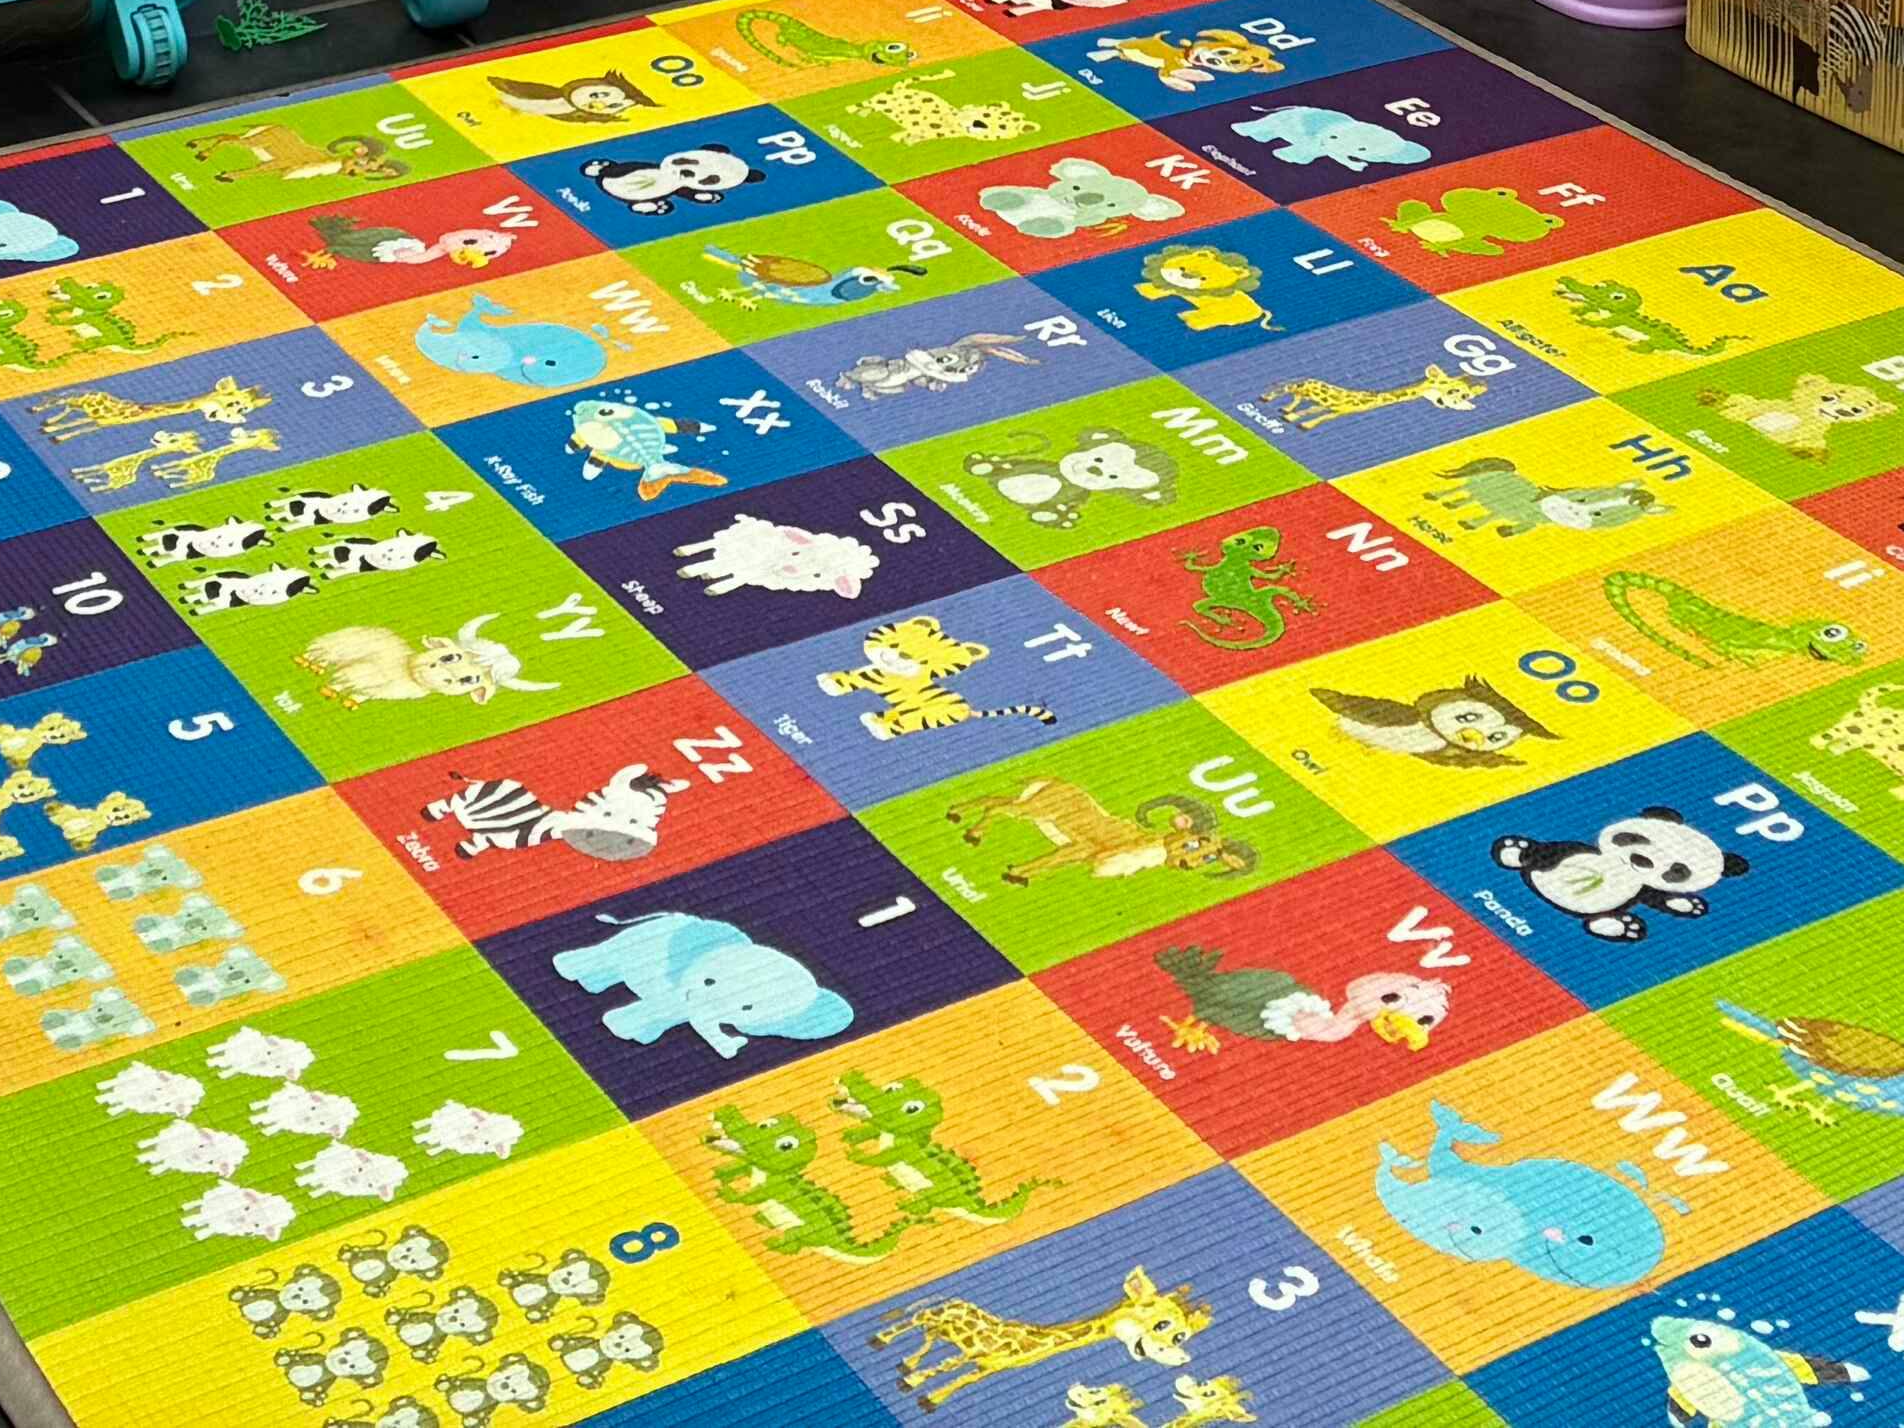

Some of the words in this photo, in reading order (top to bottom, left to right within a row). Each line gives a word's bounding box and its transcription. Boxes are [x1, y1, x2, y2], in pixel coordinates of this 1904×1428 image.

[1239, 16, 1316, 53] Dd
[650, 55, 704, 88] Oo
[1021, 79, 1072, 101] Jj
[375, 112, 434, 151] Uu
[1383, 96, 1442, 129] Ee
[756, 129, 818, 166] Pp
[1144, 153, 1211, 192] Kk
[100, 186, 146, 205] 1
[482, 194, 540, 230] Vv
[1537, 181, 1607, 209] Ff
[885, 218, 953, 262] Qq
[1292, 247, 1356, 277] Ll
[1678, 262, 1770, 304] Aa
[191, 273, 244, 297] 2
[589, 278, 669, 335] Ww
[1022, 313, 1088, 349] Rr
[1496, 318, 1568, 359] Alligator
[1443, 334, 1518, 376] Gg
[300, 374, 354, 398] 3
[719, 388, 791, 435] Xx
[1152, 405, 1250, 465] Mm
[1609, 433, 1692, 483] Hh
[422, 489, 475, 512] 4
[859, 500, 926, 546] Ss
[1326, 521, 1409, 574] Nn
[51, 571, 124, 616] 10
[620, 578, 664, 617] Sheep
[536, 592, 606, 642] Yy
[1024, 622, 1094, 664] Tt
[1517, 649, 1601, 703] Oo
[167, 711, 234, 741] 5
[772, 712, 813, 746] Tiger
[672, 725, 755, 785] Zz
[1290, 748, 1328, 776] Owl
[1188, 755, 1277, 820] Uu
[1714, 781, 1805, 843] Pp
[396, 830, 440, 874] Zebra
[299, 867, 365, 896] 6
[940, 866, 987, 905] Urial
[857, 896, 916, 929] 1
[1473, 889, 1533, 939] Panda
[1386, 905, 1472, 970] Vv
[443, 1030, 519, 1061] 7
[1115, 1024, 1176, 1081] Vulture
[1026, 1063, 1102, 1106] 2
[1710, 1071, 1772, 1120] Quail
[1591, 1072, 1731, 1177] Ww
[608, 1221, 681, 1266] 8
[1248, 1264, 1319, 1311] 3
